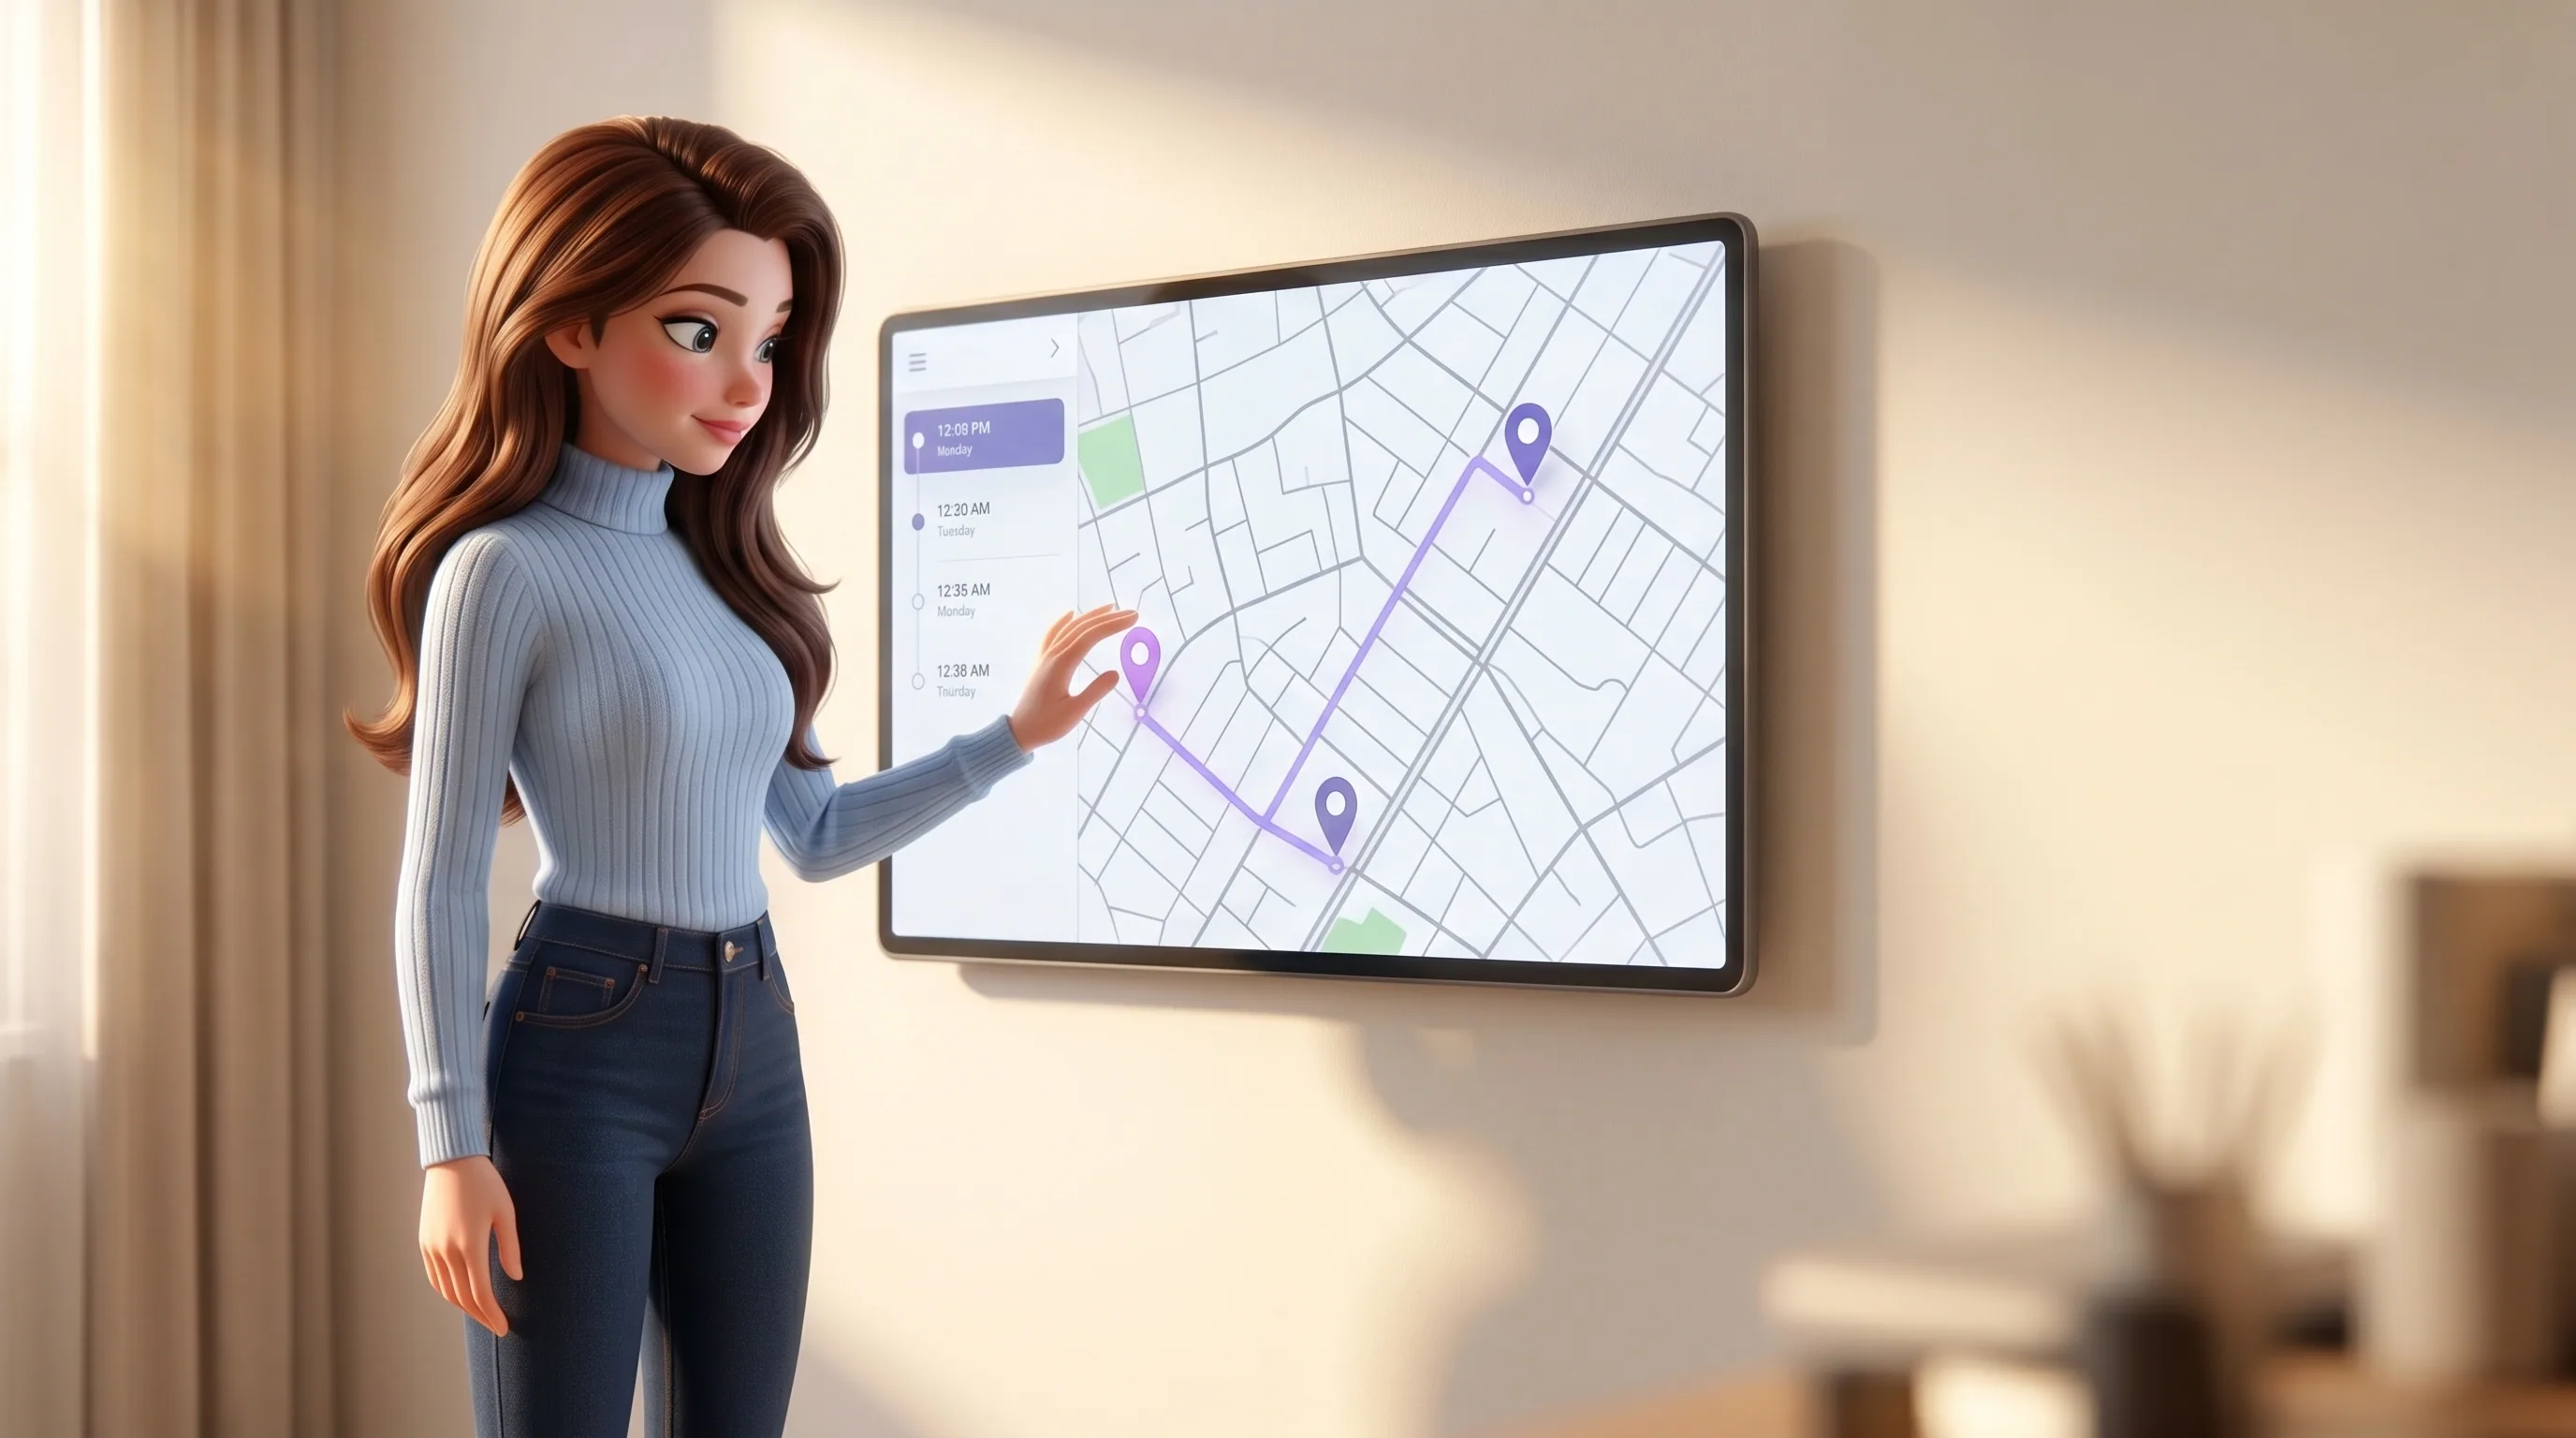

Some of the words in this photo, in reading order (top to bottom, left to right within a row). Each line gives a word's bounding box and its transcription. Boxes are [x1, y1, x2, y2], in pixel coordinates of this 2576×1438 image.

[938, 422, 969, 437] 12:08
[971, 420, 990, 435] PM
[937, 443, 973, 458] Monday
[971, 501, 990, 516] AM
[937, 523, 975, 539] Tuesday
[971, 582, 990, 596] AM
[937, 604, 975, 619] Monday
[970, 663, 989, 677] AM
